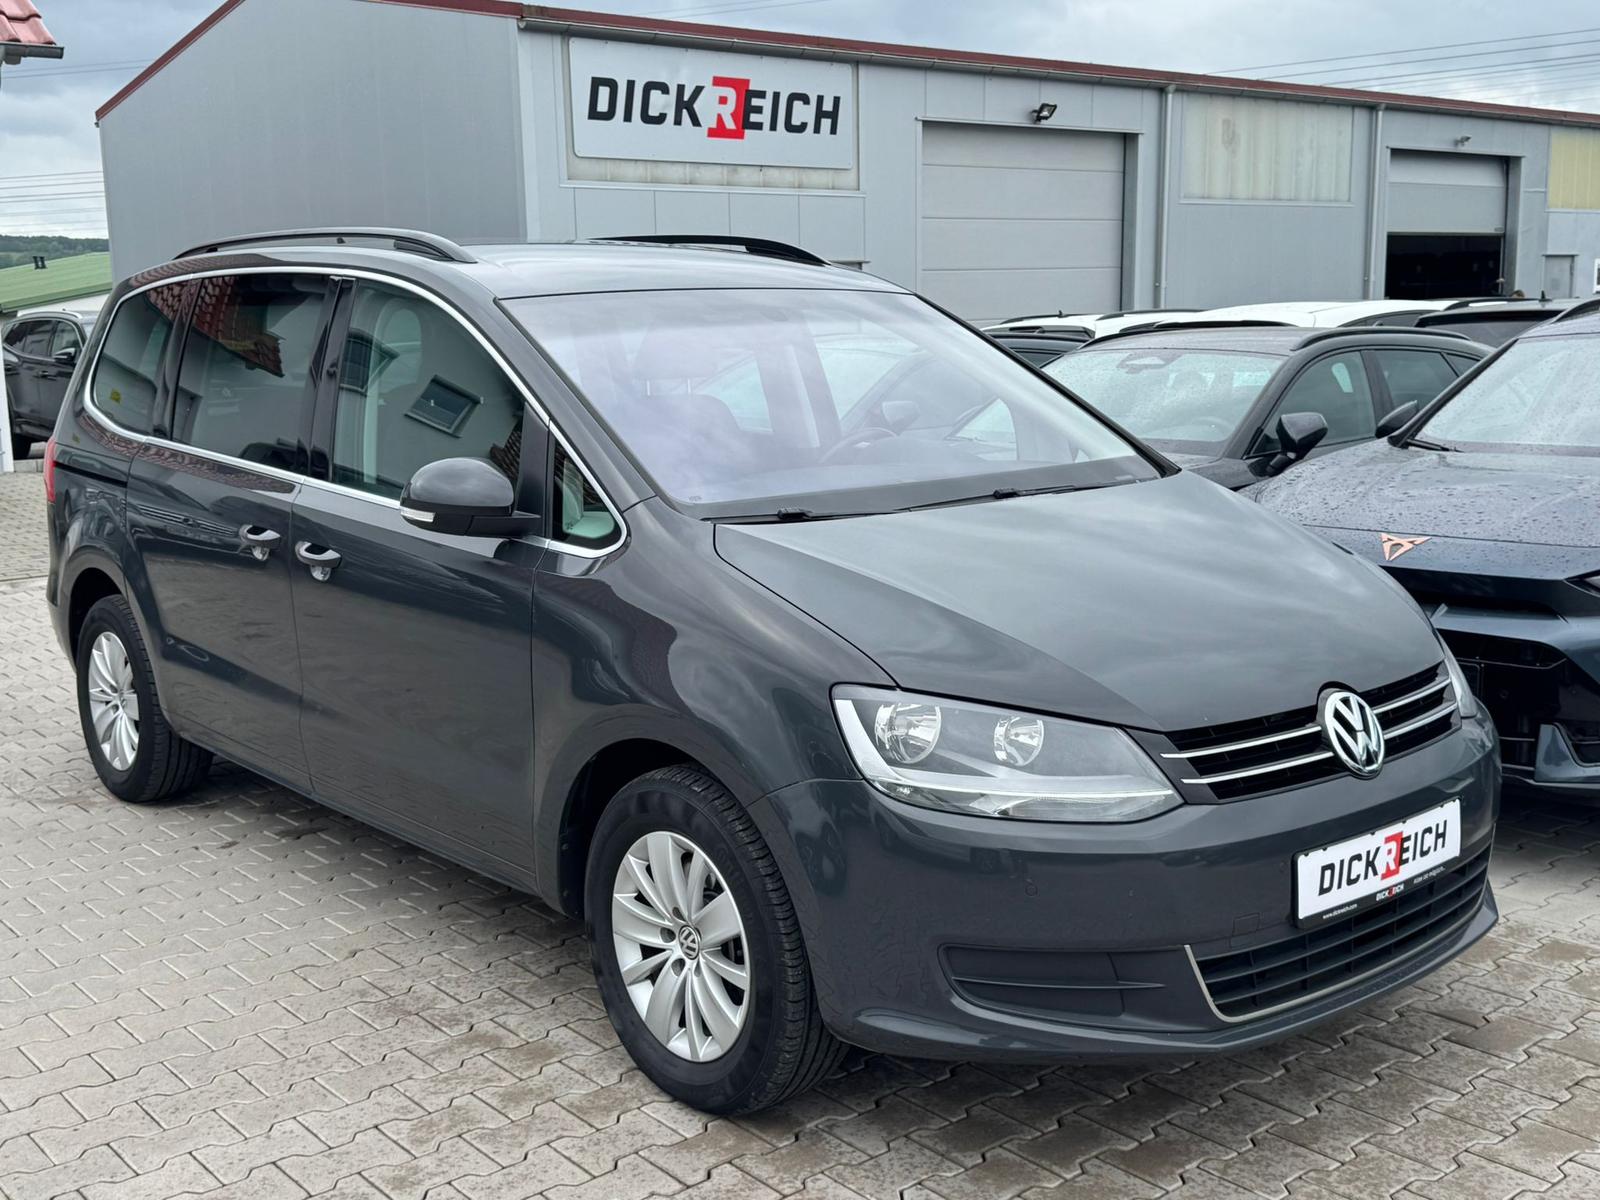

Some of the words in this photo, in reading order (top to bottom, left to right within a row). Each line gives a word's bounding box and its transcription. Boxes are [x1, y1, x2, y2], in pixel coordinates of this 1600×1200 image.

[587, 75, 841, 140] DICKREICH
[1325, 692, 1384, 775] VW
[1318, 819, 1448, 897] DICKREICH
